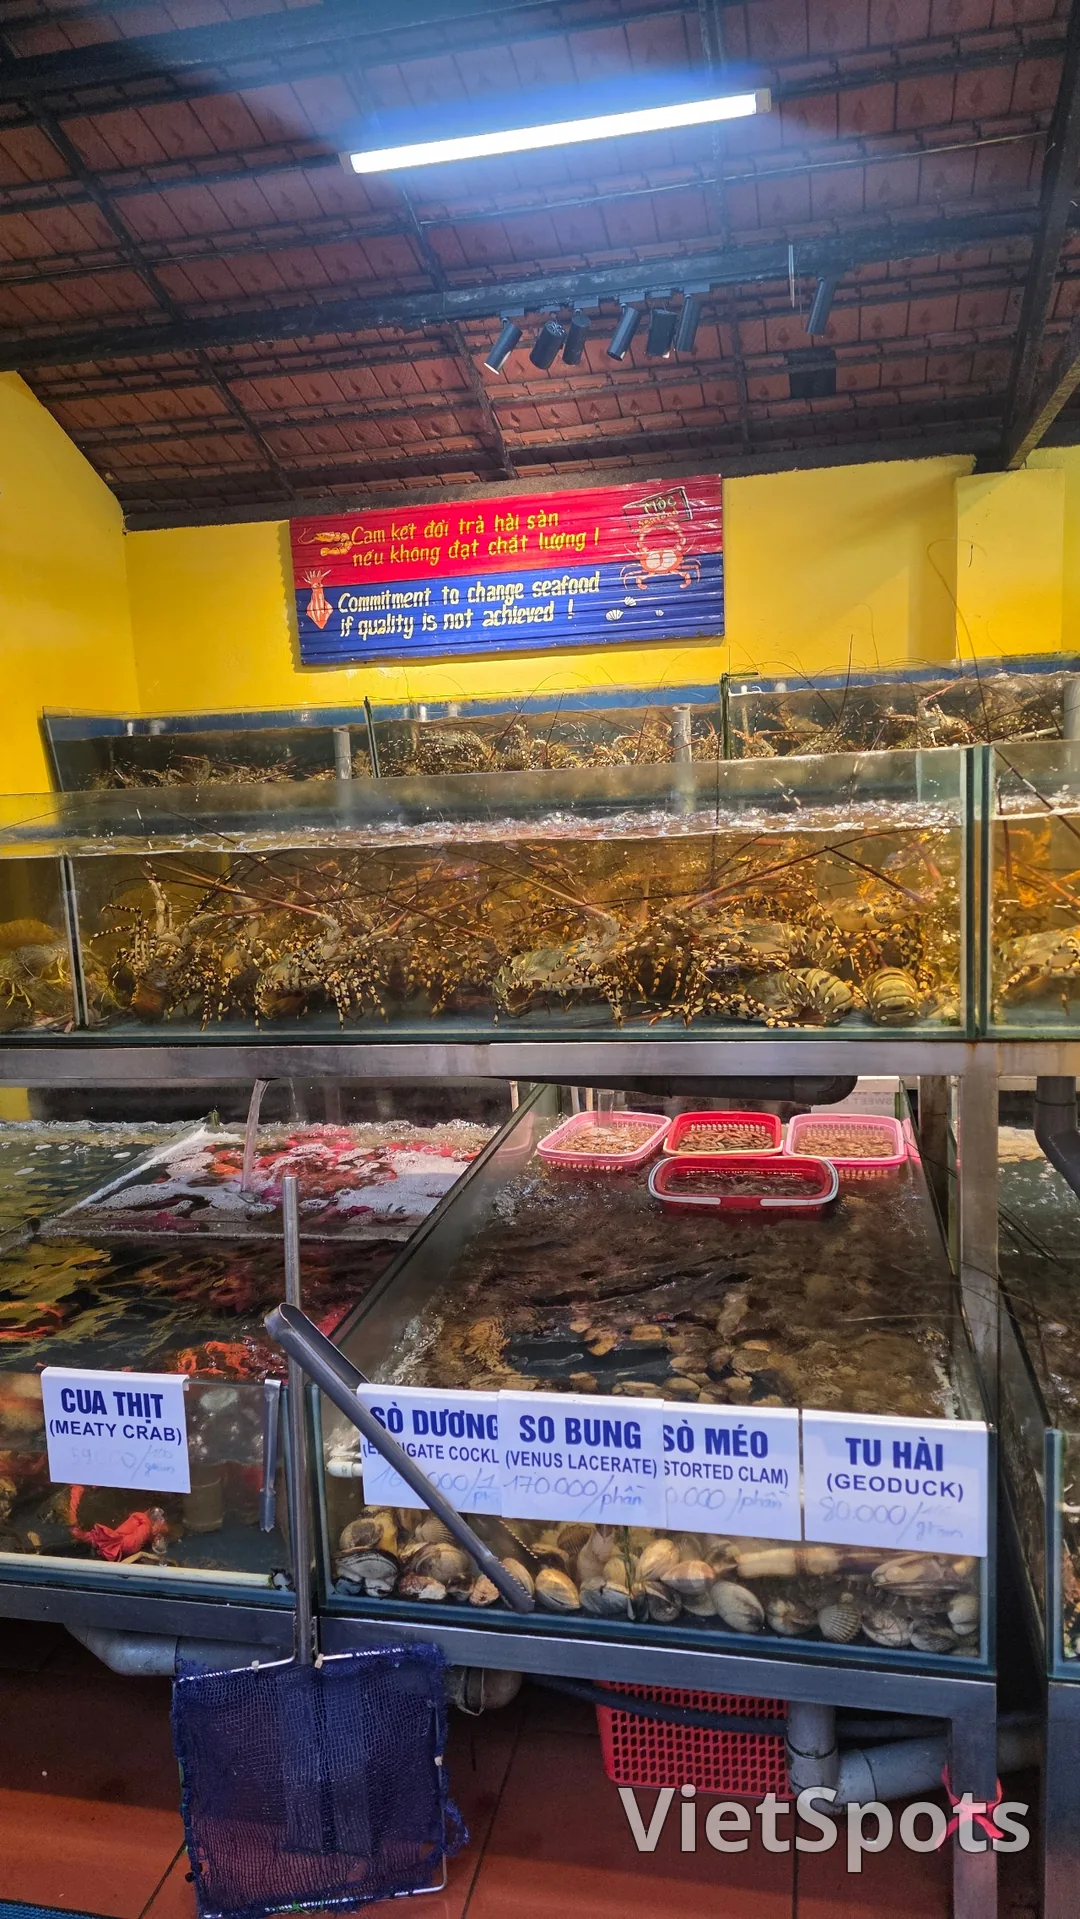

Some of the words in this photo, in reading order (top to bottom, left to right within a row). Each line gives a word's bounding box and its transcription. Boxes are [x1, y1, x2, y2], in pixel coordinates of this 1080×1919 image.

[351, 526, 385, 545] Cam
[391, 523, 417, 543] kết
[424, 519, 449, 539] đổi
[459, 515, 484, 535] trả
[495, 513, 519, 532] hải
[527, 509, 559, 528] sản
[352, 549, 384, 567] nếu
[390, 544, 440, 566] không
[448, 538, 479, 560] đạt
[488, 534, 528, 556] chất
[539, 531, 587, 552] lượng
[337, 587, 431, 613] Commitment
[442, 586, 460, 605] to
[467, 581, 524, 606] change
[532, 570, 600, 599] seafood
[340, 616, 355, 637] if
[357, 613, 414, 641] quality
[421, 613, 437, 632] is
[443, 608, 473, 630] not
[482, 600, 555, 627] achieved
[60, 1388, 107, 1415] CUA
[113, 1391, 163, 1424] THỊT
[370, 1402, 404, 1434] SÒ
[412, 1409, 498, 1440] DƯƠNG
[50, 1419, 117, 1438] (MEATY
[123, 1424, 182, 1446] CRAB)
[519, 1414, 554, 1443] SO
[565, 1417, 641, 1449] BUNG
[663, 1419, 695, 1453] SÒ
[704, 1423, 768, 1459] MÉO
[506, 1450, 563, 1469] (VENUS
[568, 1455, 658, 1479] LACERATE)
[845, 1437, 881, 1467] TU
[893, 1436, 944, 1472] HÀI
[738, 1466, 789, 1489] CLAM)
[827, 1473, 964, 1502] (GEODUCK)
